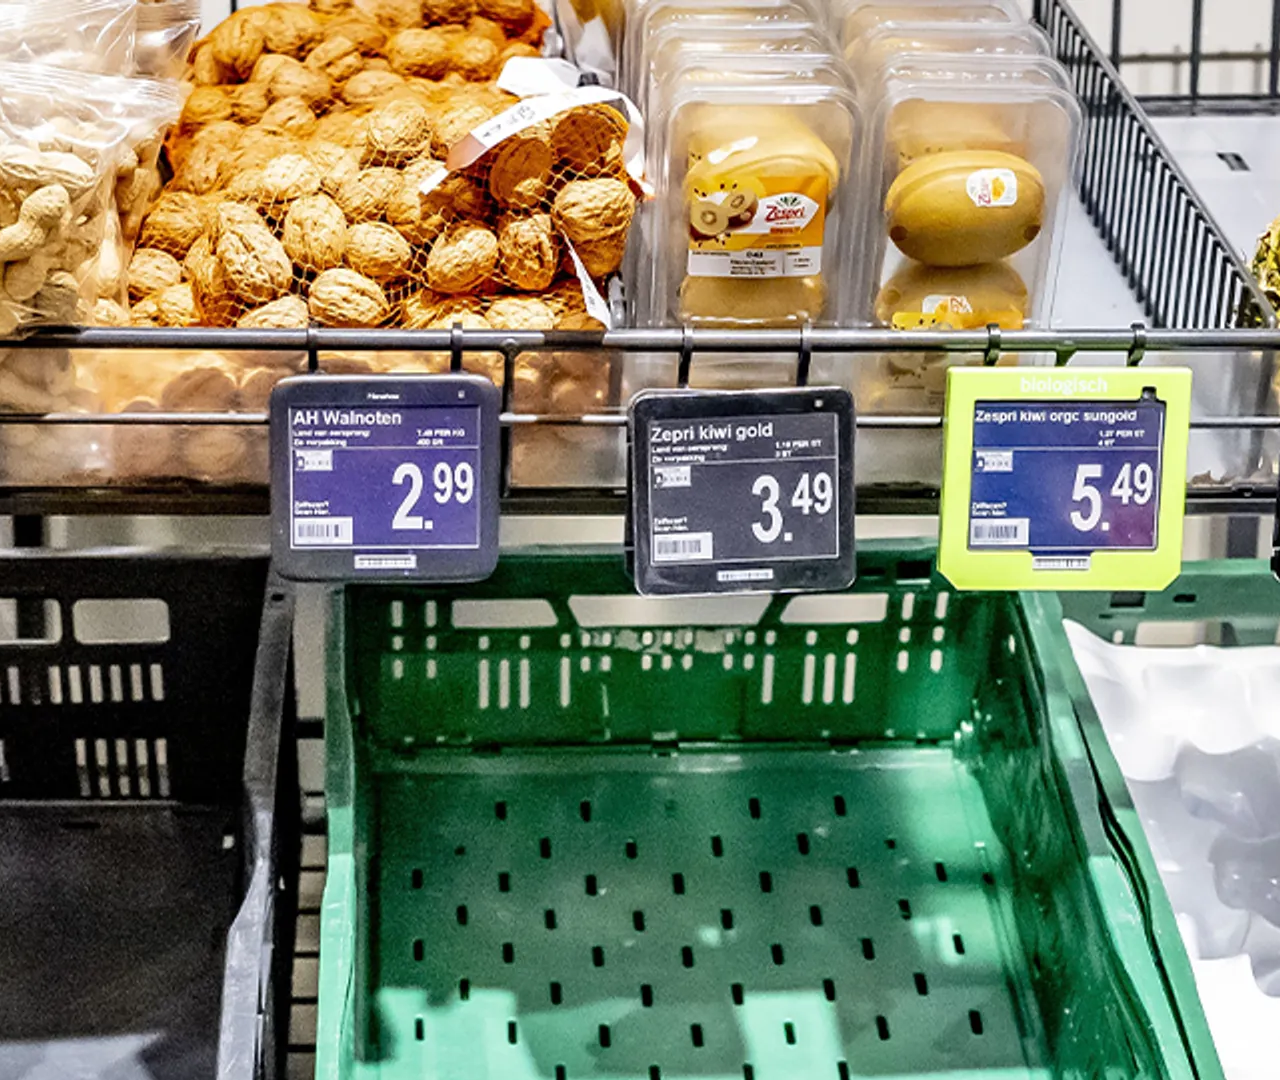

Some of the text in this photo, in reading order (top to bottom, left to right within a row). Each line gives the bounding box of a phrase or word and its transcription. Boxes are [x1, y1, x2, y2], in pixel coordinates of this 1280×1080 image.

[1020, 377, 1108, 395] biologisch
[293, 411, 401, 424] AH Walnoten
[975, 410, 1137, 423] Zespri kiwi orgc sungold
[651, 423, 773, 442] Zepri kiwi gold
